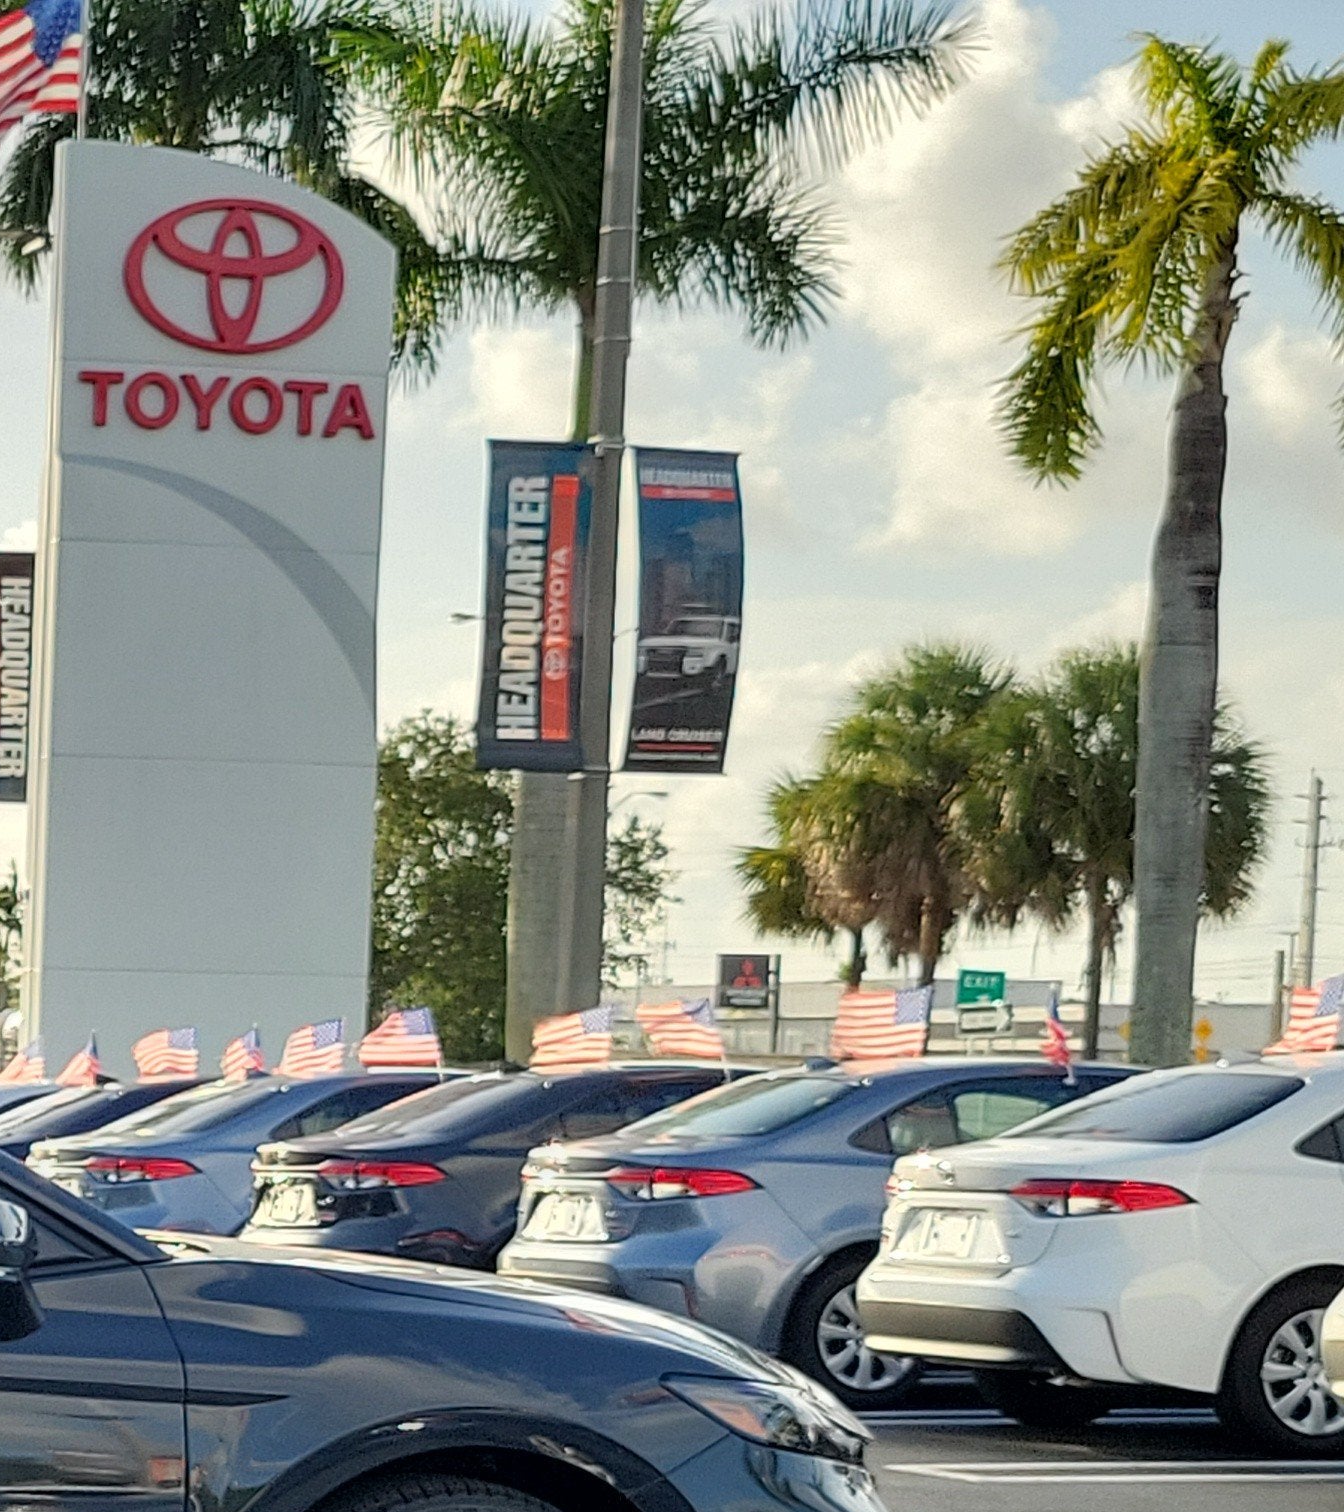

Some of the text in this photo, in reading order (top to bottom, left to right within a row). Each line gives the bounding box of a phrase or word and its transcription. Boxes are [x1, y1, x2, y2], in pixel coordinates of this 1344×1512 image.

[78, 371, 375, 440] TOYOTA
[496, 474, 550, 741] HEADQUARTER
[546, 547, 570, 640] TOYOTA
